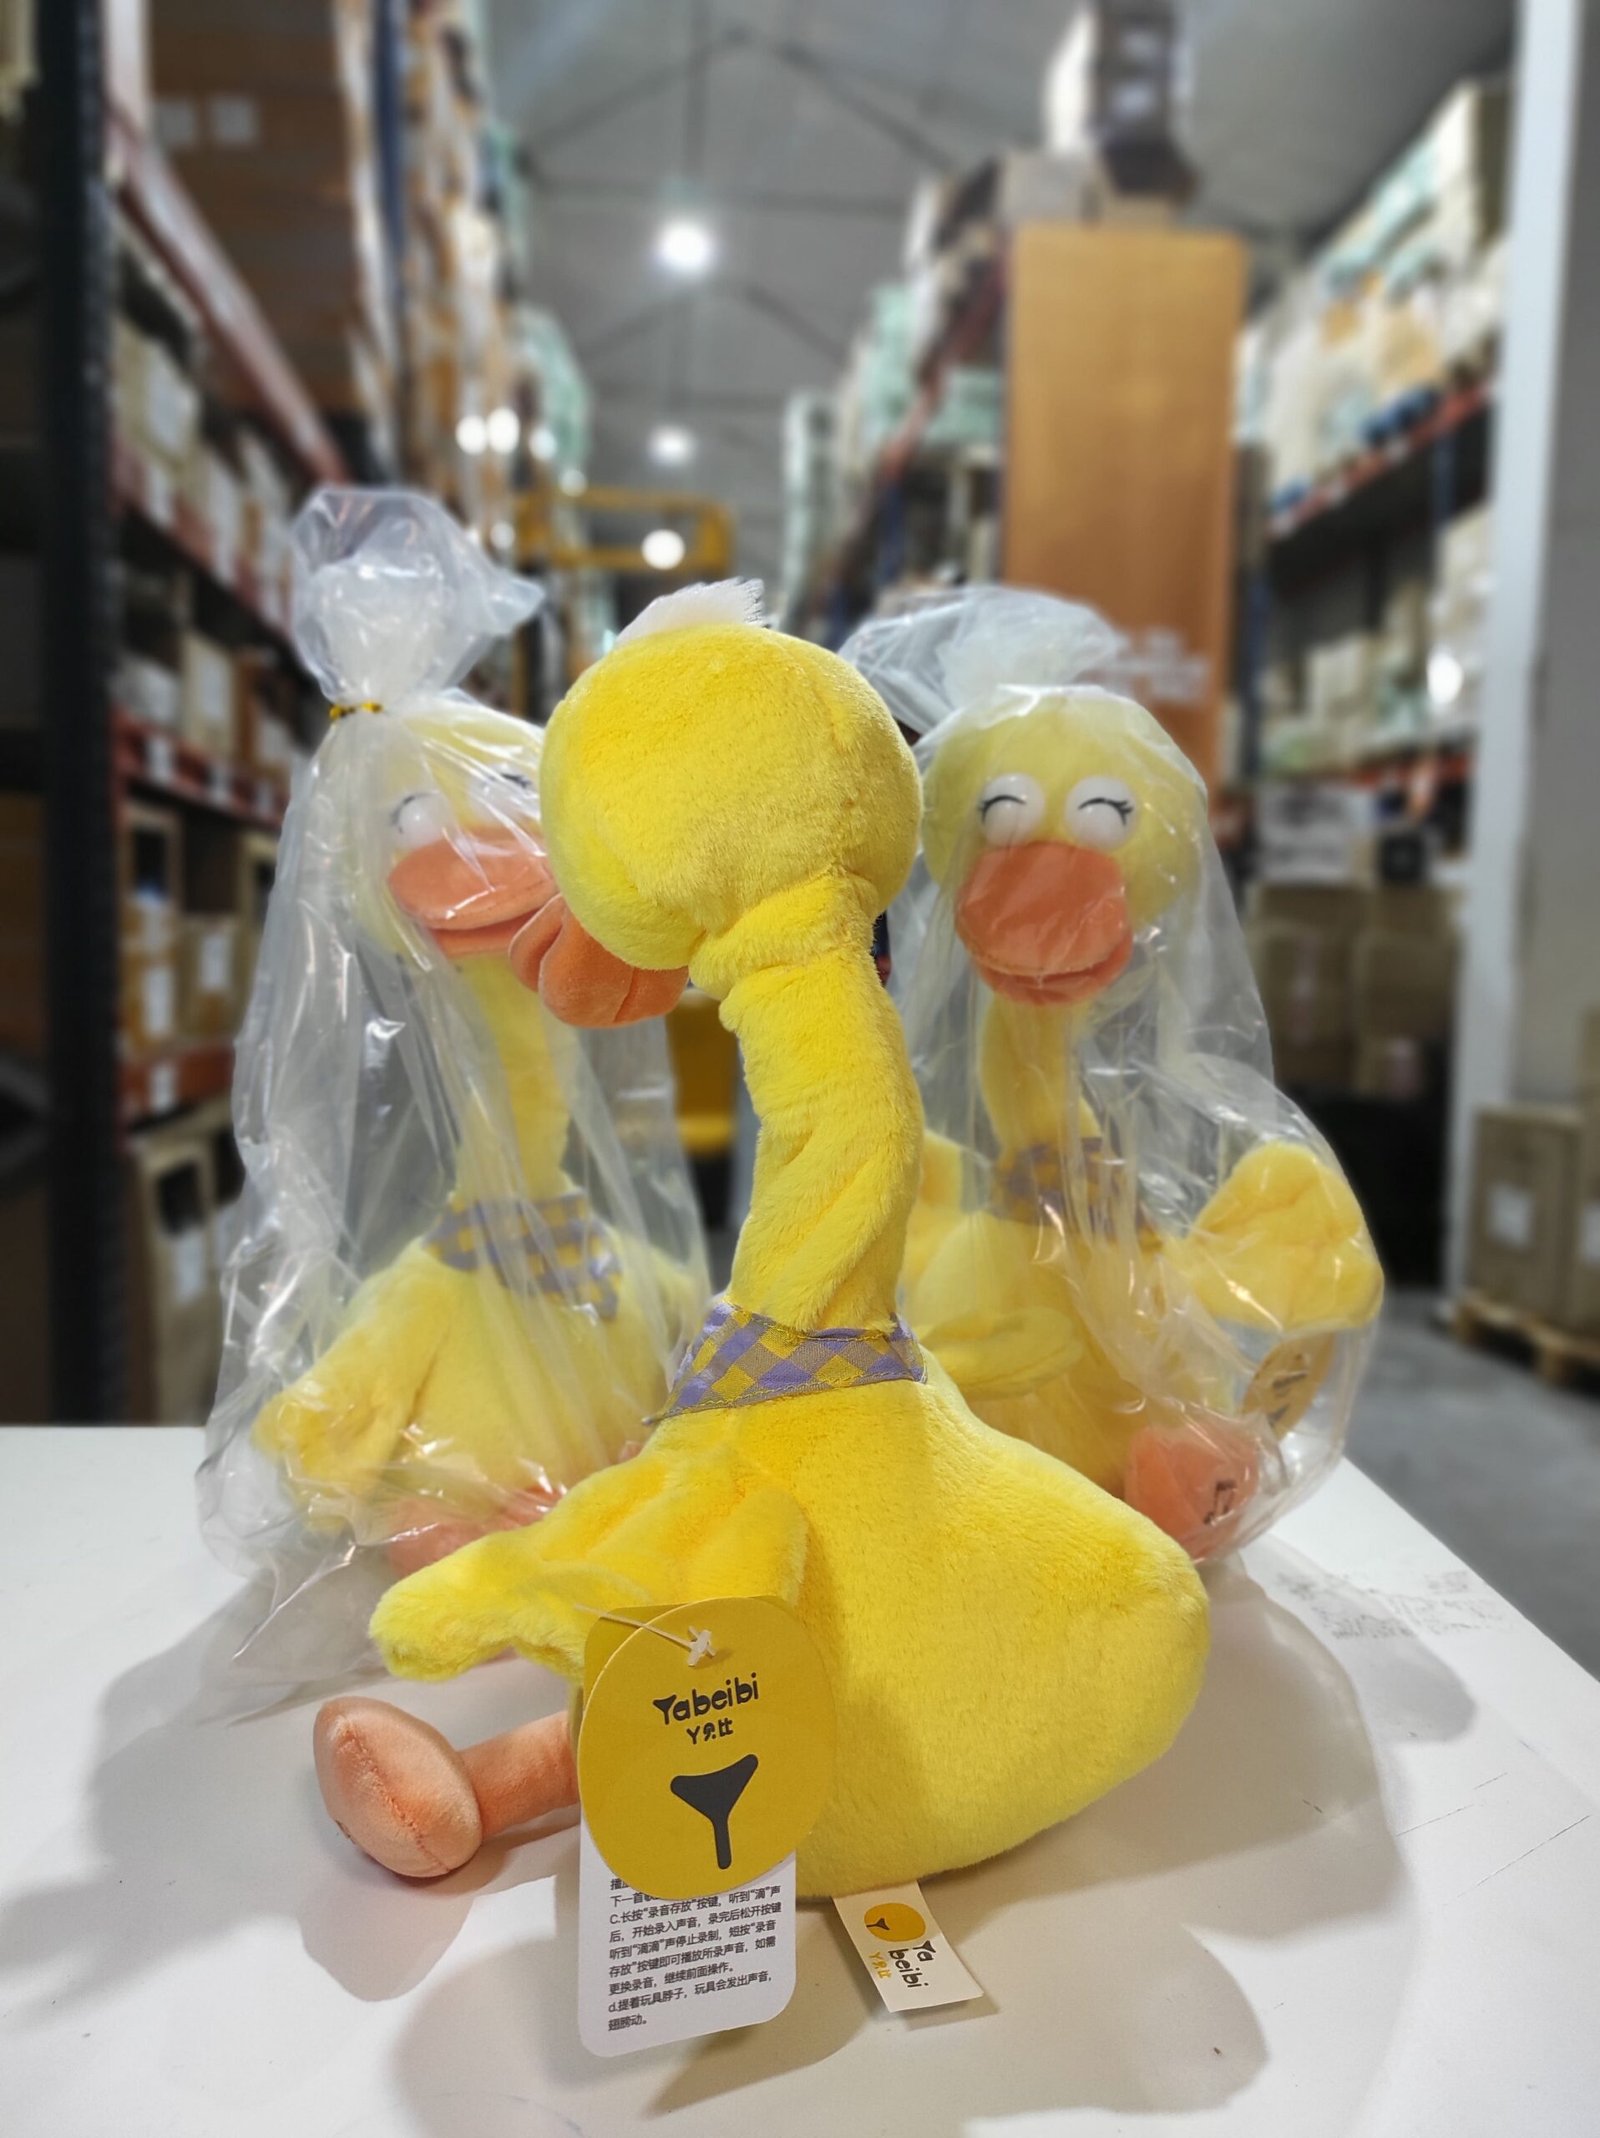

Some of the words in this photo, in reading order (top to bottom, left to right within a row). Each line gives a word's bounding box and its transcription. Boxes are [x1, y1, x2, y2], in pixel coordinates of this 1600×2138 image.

[652, 1672, 759, 1726] Yabeibi
[888, 1948, 930, 1988] beibi
[912, 1940, 937, 1962] Ya
